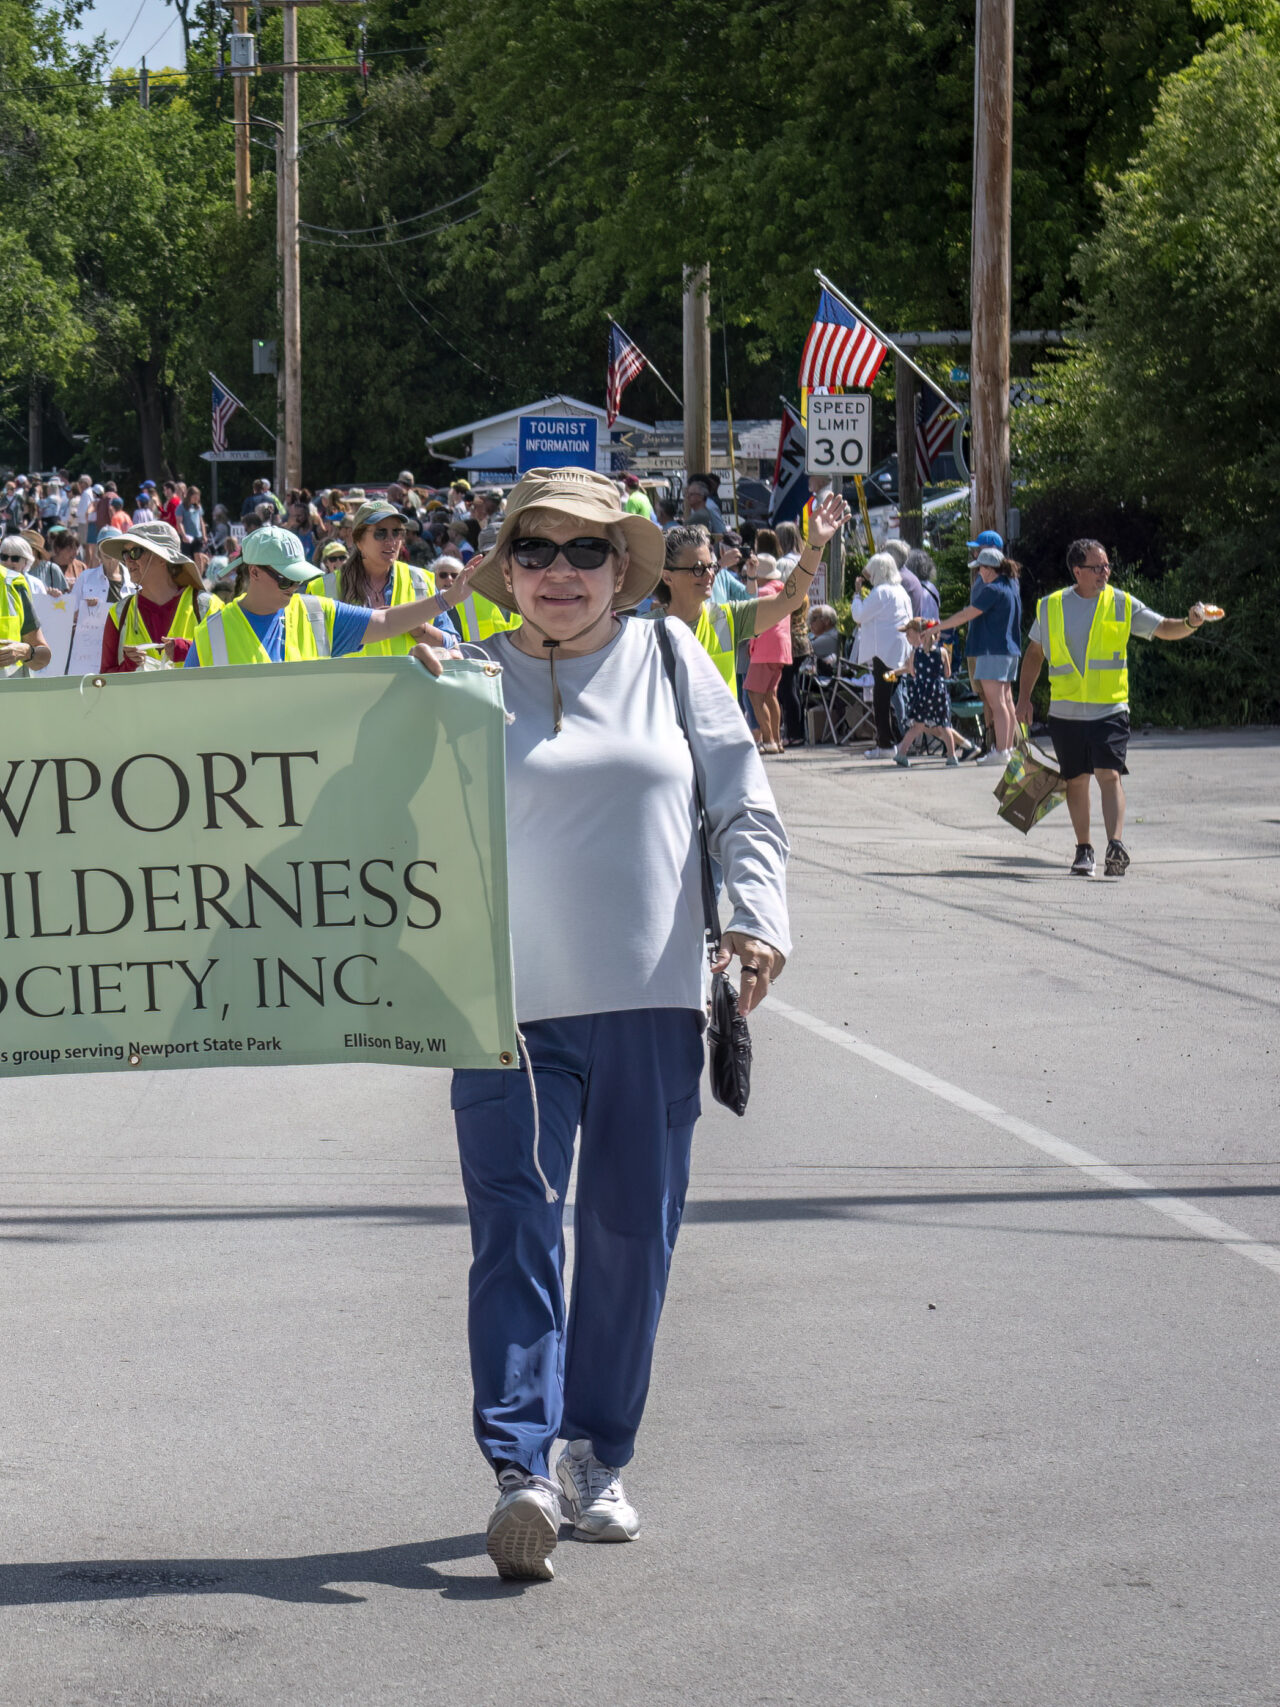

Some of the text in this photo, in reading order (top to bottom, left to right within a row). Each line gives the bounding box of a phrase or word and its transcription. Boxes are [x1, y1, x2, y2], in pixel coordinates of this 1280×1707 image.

[813, 402, 865, 414] SPEED
[530, 421, 587, 435] TOURIST
[818, 419, 859, 431] LIMIT
[525, 439, 590, 452] INFORMATION
[814, 438, 864, 466] 30
[253, 954, 394, 1009] INC.
[12, 1049, 61, 1066] group
[64, 1043, 125, 1060] serving
[127, 1040, 200, 1058] Newport
[203, 1037, 243, 1052] State
[246, 1036, 283, 1051] Park
[343, 1033, 447, 1054] Ellison Bay, WI
